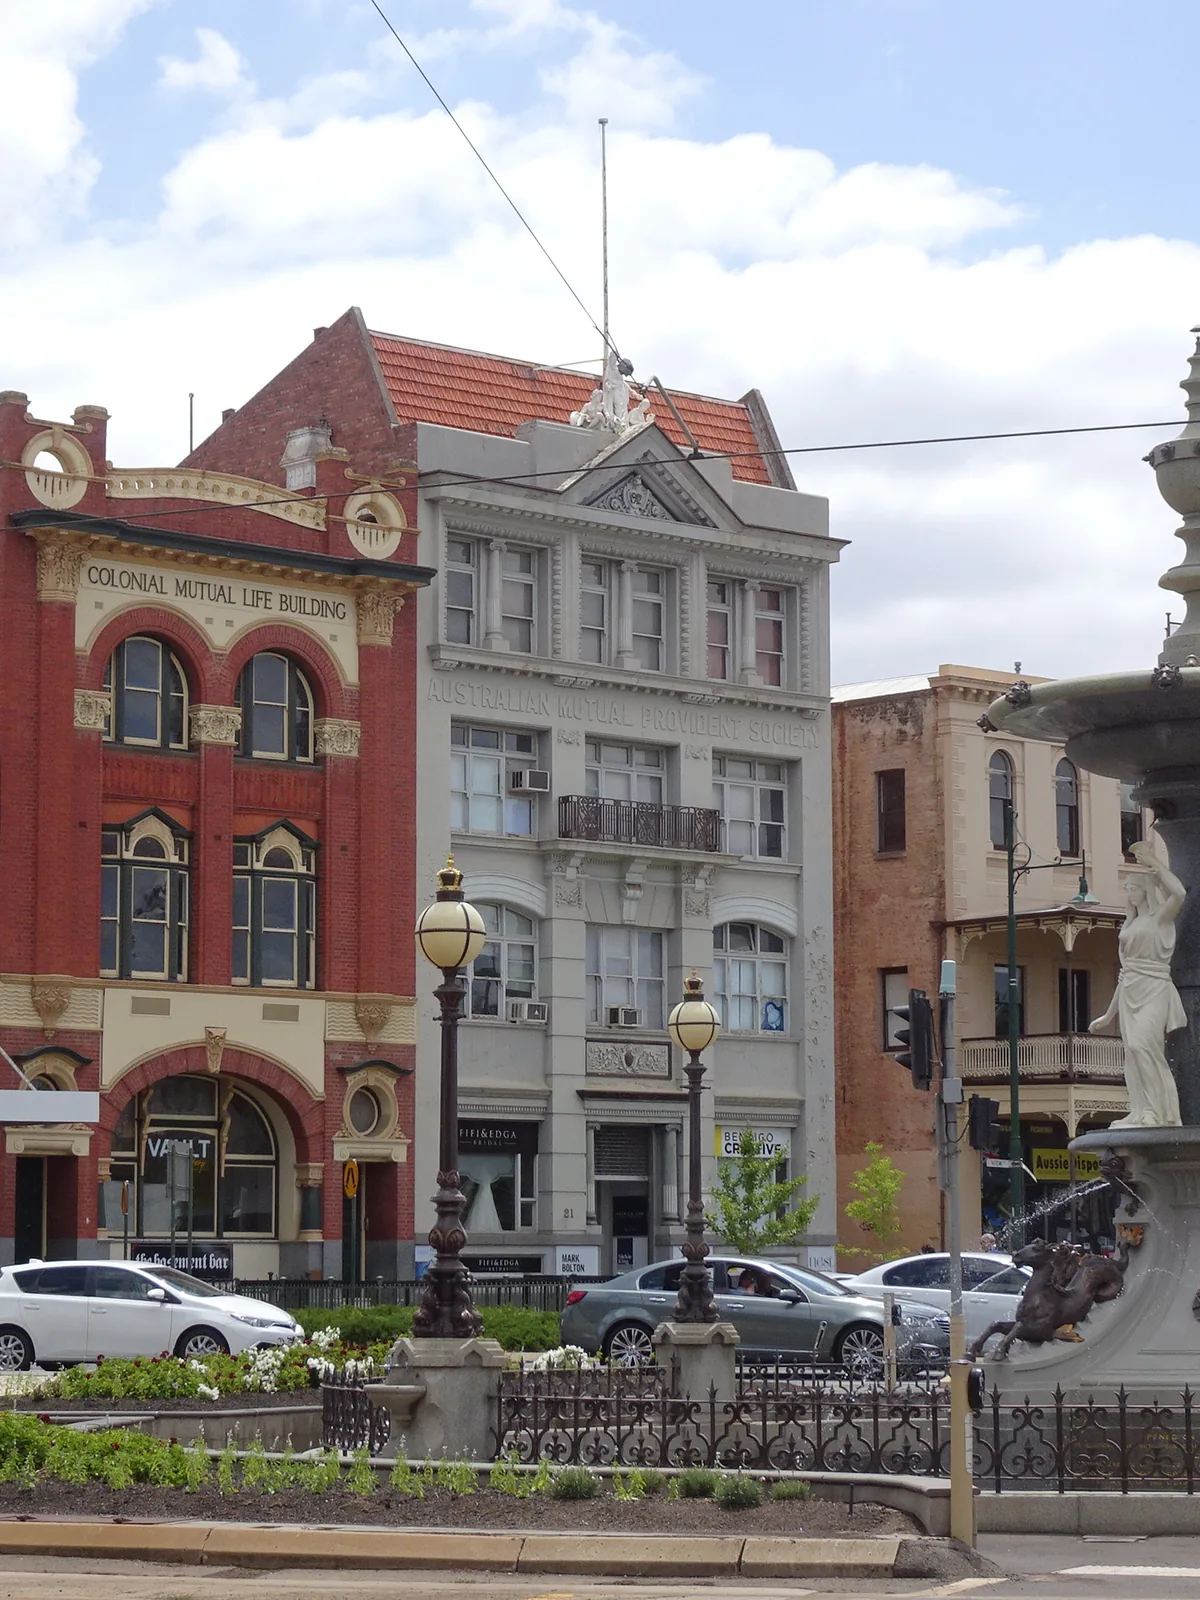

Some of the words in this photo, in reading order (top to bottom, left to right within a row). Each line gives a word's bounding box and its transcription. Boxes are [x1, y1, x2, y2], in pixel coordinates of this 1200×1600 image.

[88, 566, 168, 595] COLONIAL
[175, 578, 236, 604] MUTUAL
[243, 588, 273, 610] LIFE
[279, 594, 346, 620] BUILDING
[427, 677, 550, 716] AUSTRALIAN
[558, 693, 634, 727] MUTUAL
[641, 704, 741, 740] PROVIDENT
[749, 720, 820, 749] SOCIETY
[460, 1128, 517, 1139] FIFI&EDGA
[148, 1138, 211, 1158] VALT
[1036, 1155, 1069, 1170] Aussie
[564, 1208, 574, 1218] 21
[209, 1253, 229, 1270] bar
[561, 1254, 580, 1263] MARK
[561, 1264, 585, 1273] BOLTON
